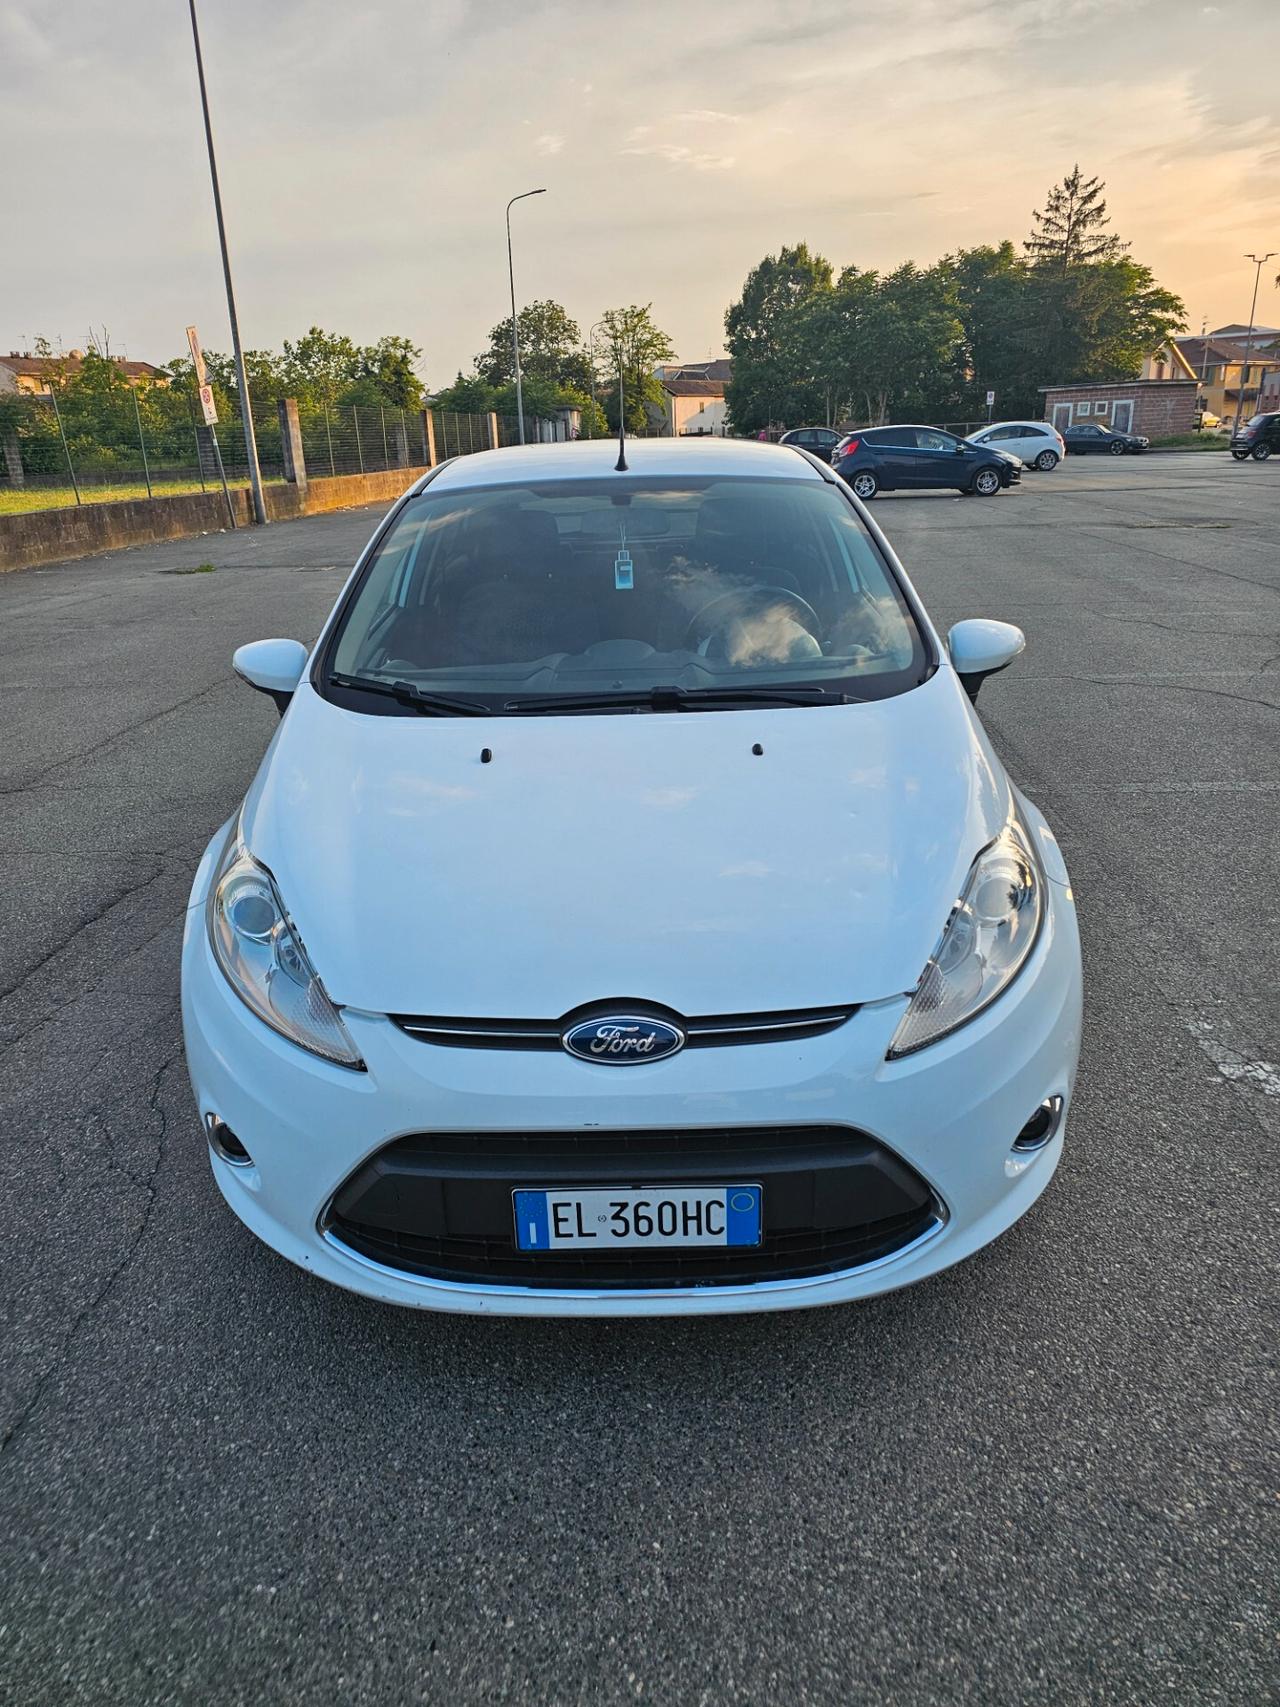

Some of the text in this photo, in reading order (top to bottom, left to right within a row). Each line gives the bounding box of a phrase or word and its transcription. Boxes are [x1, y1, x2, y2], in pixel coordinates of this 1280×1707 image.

[590, 1025, 656, 1053] Ford
[552, 1200, 725, 1238] EL 360HC
